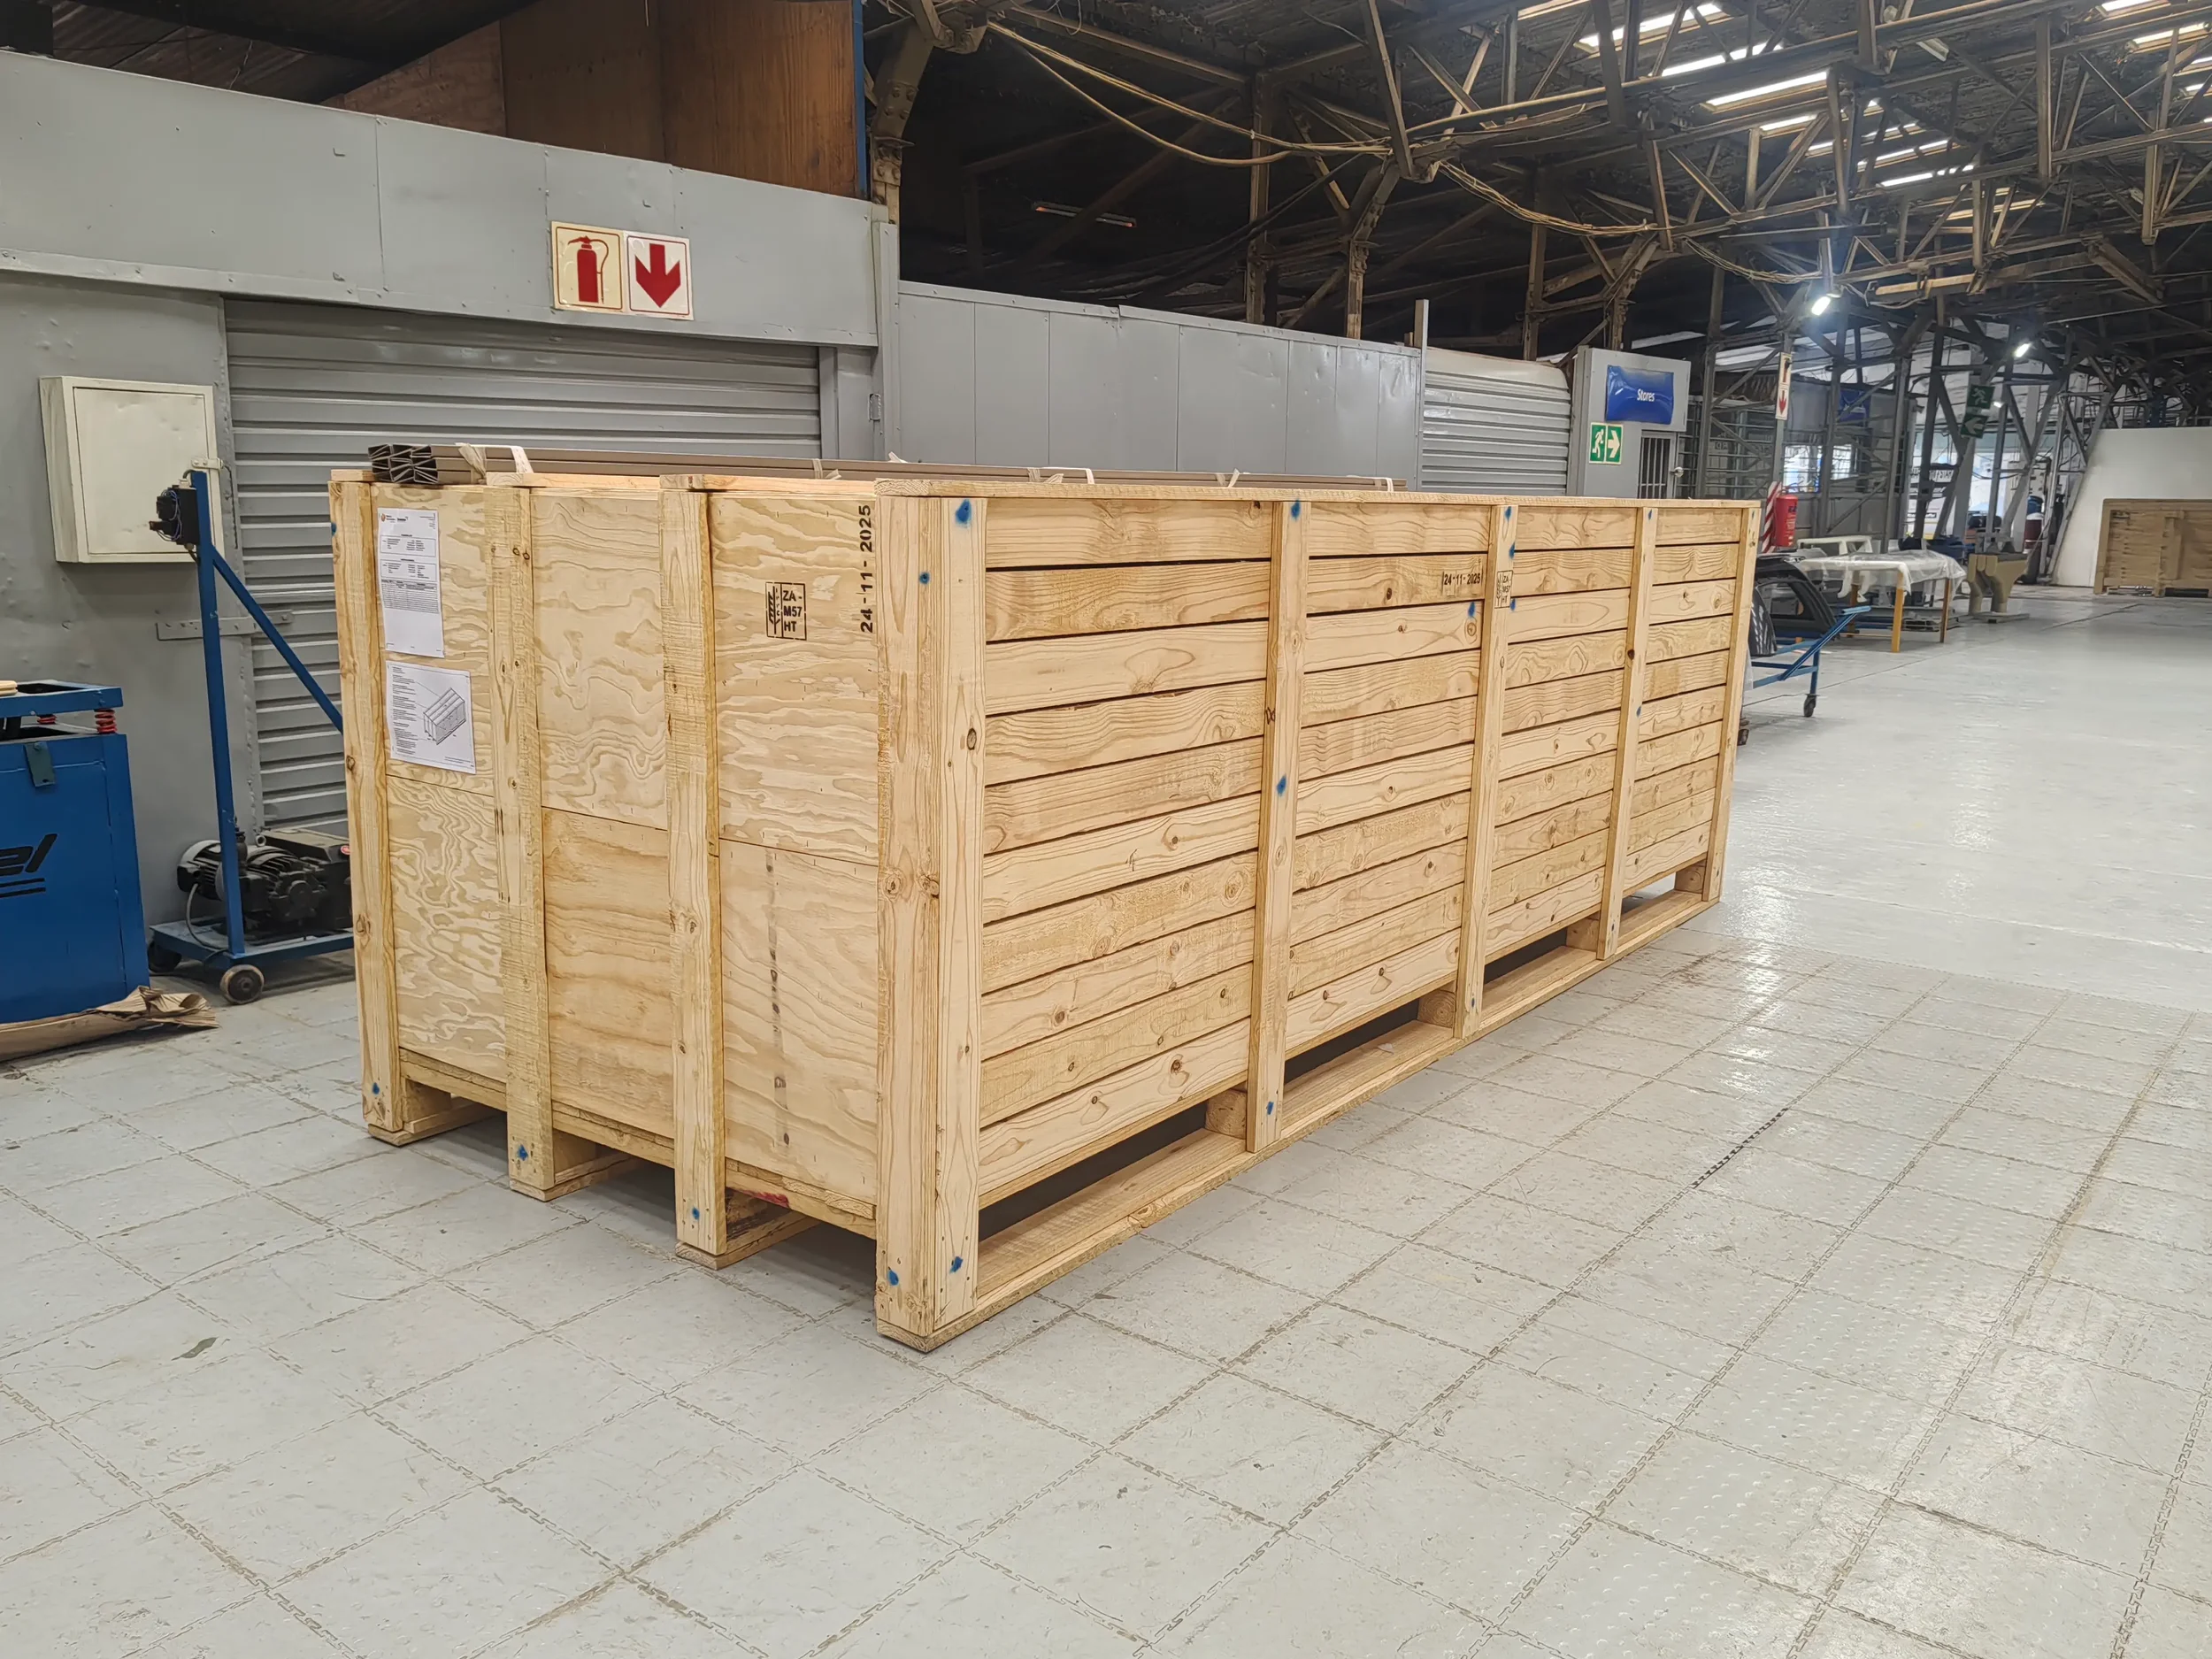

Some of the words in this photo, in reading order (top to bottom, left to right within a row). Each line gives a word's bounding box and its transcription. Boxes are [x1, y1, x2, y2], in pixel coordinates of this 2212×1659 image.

[1637, 388, 1655, 402] Stores
[783, 606, 803, 617] M57
[784, 620, 796, 632] HT
